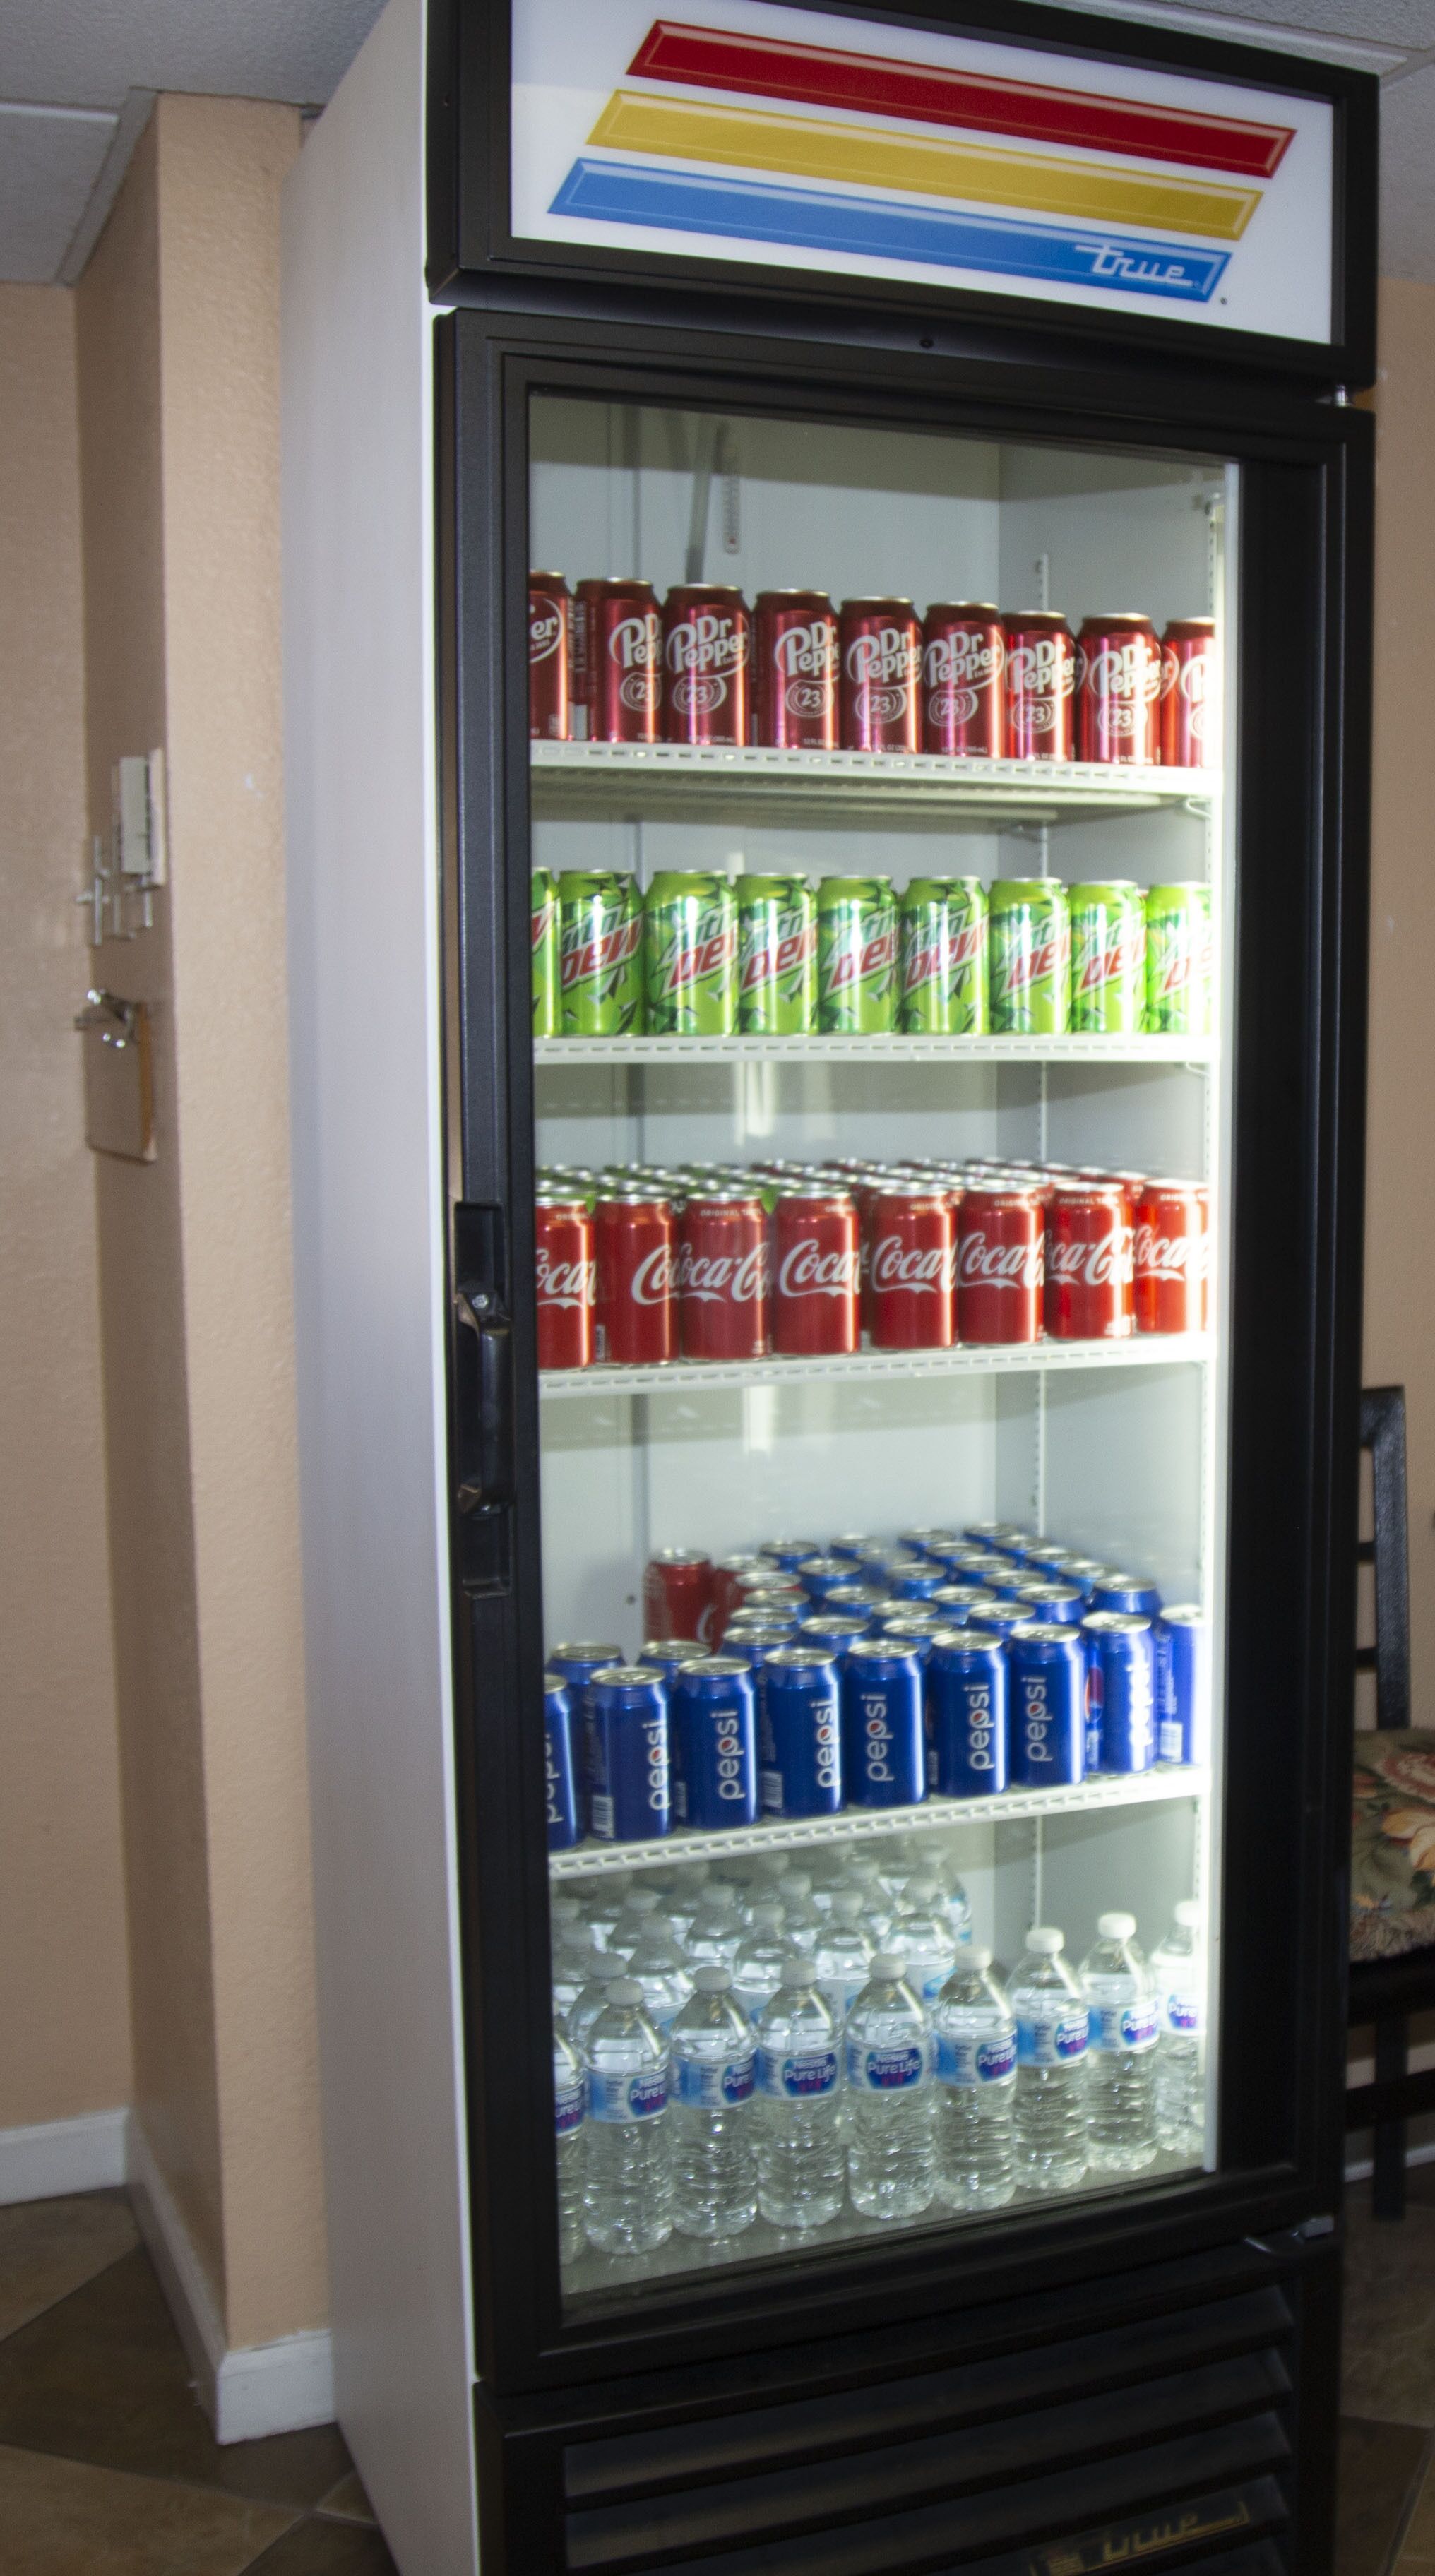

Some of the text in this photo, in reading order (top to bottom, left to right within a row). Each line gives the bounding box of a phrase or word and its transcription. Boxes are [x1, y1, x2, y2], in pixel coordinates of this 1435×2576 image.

[1074, 244, 1193, 287] true
[696, 614, 732, 645] Dr
[811, 621, 836, 650] Dr
[880, 628, 914, 657] Dr
[666, 623, 747, 674] Pepper
[949, 631, 984, 661] Dr
[924, 640, 1001, 688] Pepper
[686, 685, 708, 705] 23
[802, 688, 821, 708] 23
[871, 696, 891, 713] 23
[1111, 708, 1132, 729] 23
[963, 1681, 995, 1771] pepsi
[1021, 1675, 1054, 1763] pepsi
[809, 1698, 841, 1789] pepsi
[860, 1694, 895, 1782] pepsi
[642, 1719, 672, 1811] pepsi
[711, 1708, 746, 1801] pepsi
[785, 2063, 837, 2082] Pure Life
[868, 2059, 922, 2076] Pure Life
